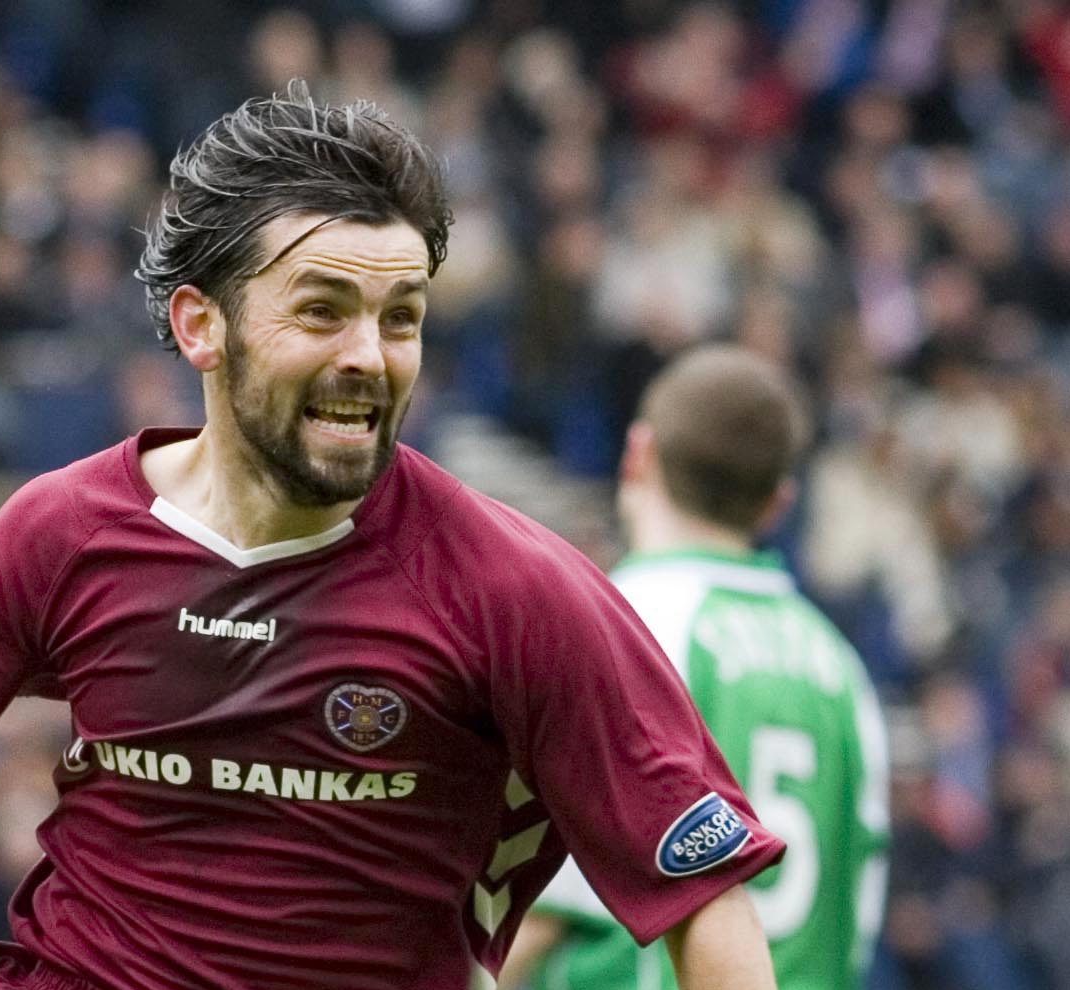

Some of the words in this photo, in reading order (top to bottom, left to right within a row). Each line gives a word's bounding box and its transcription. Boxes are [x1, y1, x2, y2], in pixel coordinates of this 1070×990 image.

[178, 607, 276, 642] hummel
[93, 741, 192, 785] UKIO
[211, 758, 418, 801] BANKAS
[671, 820, 715, 856] BANK
[750, 726, 820, 940] 5
